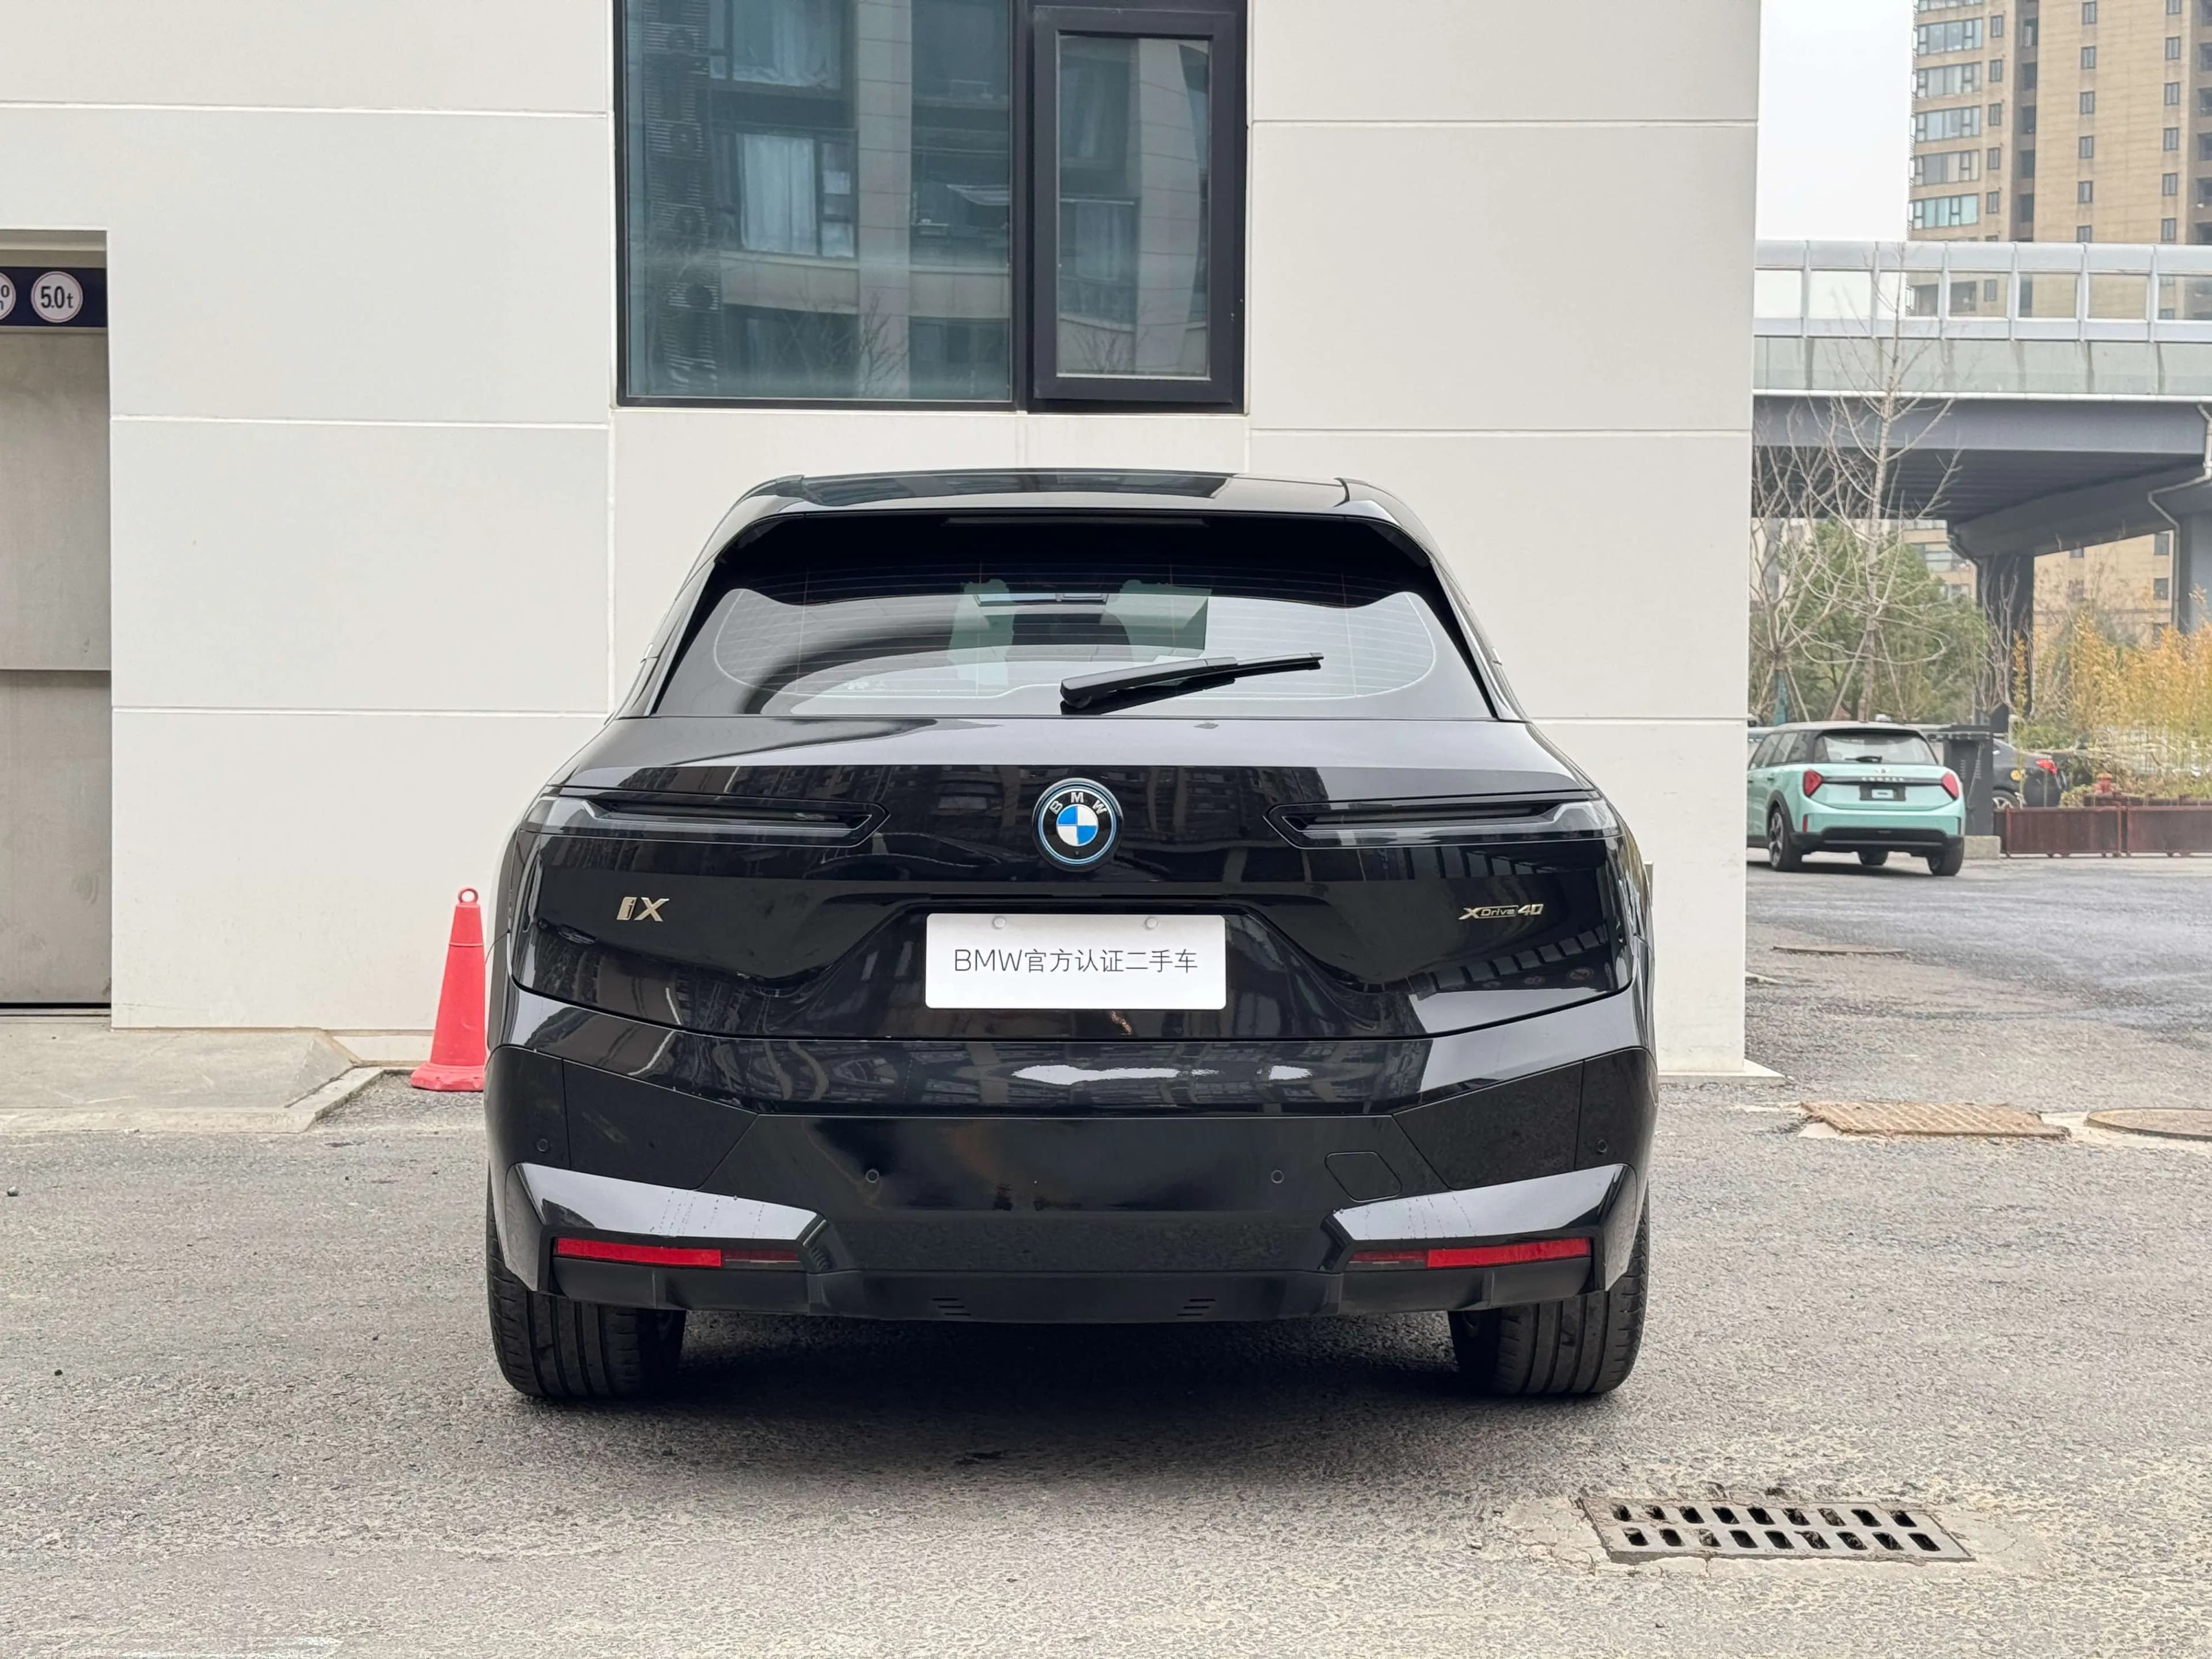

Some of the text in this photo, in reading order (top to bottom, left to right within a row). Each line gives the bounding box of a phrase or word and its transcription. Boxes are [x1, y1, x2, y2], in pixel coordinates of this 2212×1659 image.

[1049, 791, 1107, 815] BMW
[954, 948, 1198, 973] BMW官方认证二手车
